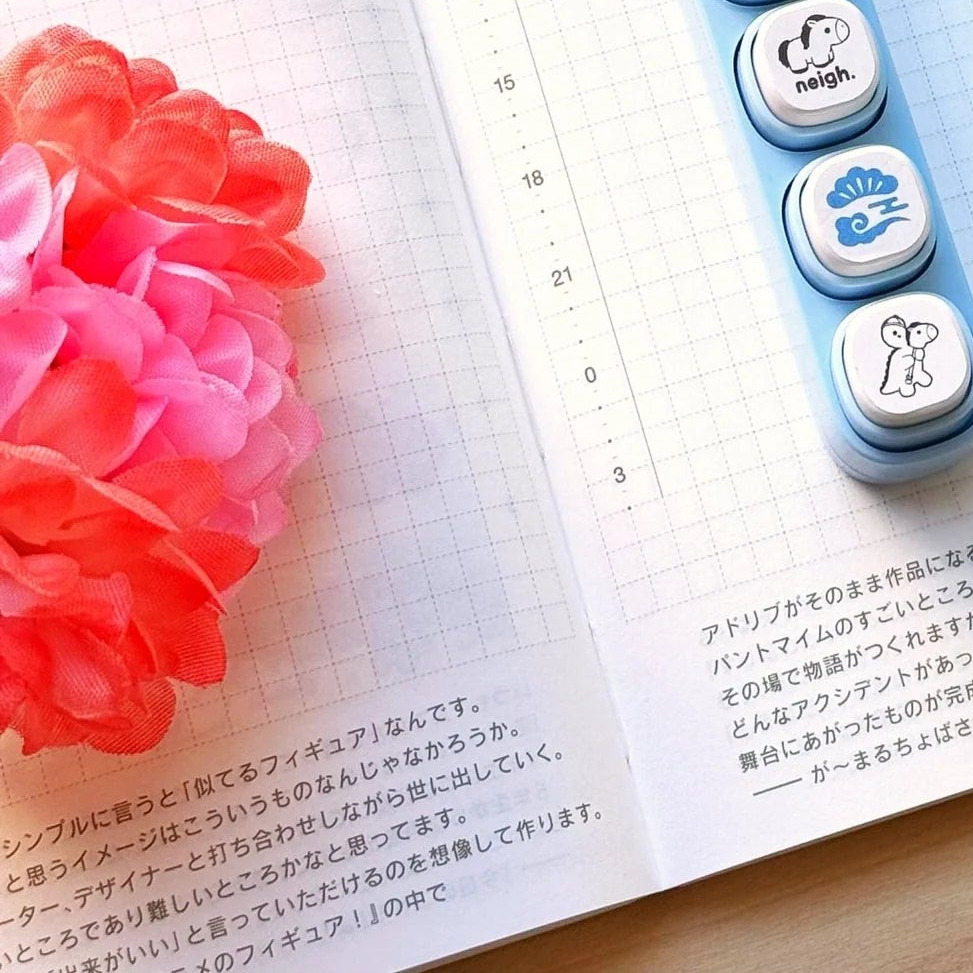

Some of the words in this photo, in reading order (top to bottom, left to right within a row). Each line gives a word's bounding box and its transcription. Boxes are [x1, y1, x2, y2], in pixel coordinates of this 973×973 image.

[493, 74, 516, 94] 15
[795, 65, 856, 94] neigh.
[521, 170, 544, 189] 18
[551, 266, 573, 286] 21
[584, 366, 597, 383] 0
[613, 467, 626, 483] 3
